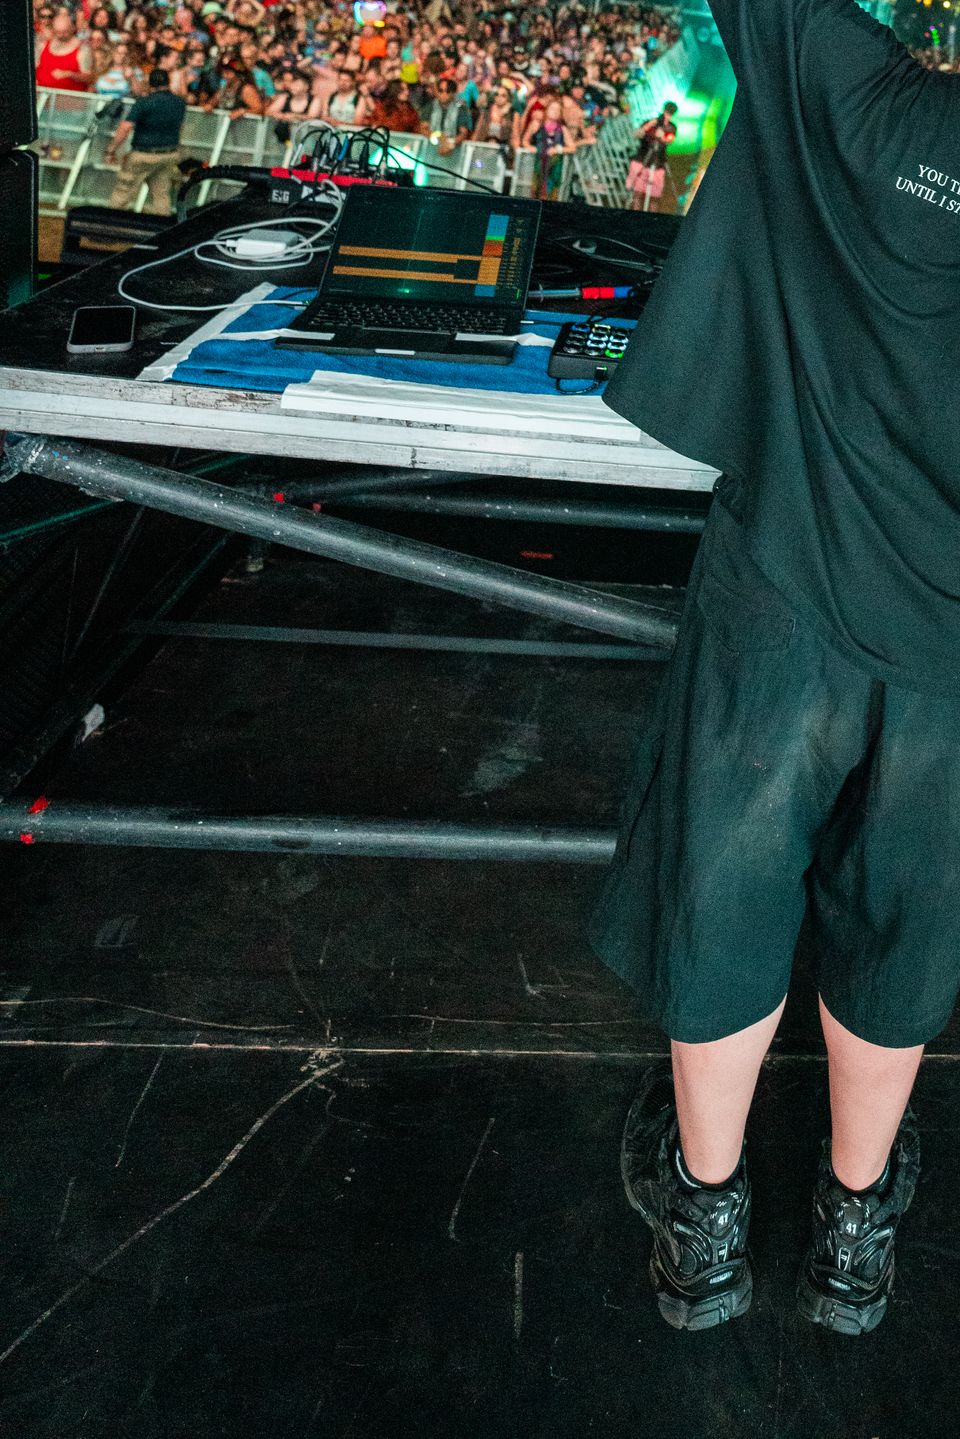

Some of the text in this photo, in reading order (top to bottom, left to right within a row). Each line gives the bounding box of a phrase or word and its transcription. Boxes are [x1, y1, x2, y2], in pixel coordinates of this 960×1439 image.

[918, 164, 950, 187] YOU
[895, 176, 938, 204] UNTIL
[938, 195, 948, 208] I
[718, 1212, 729, 1225] 41
[845, 1222, 857, 1235] 41
